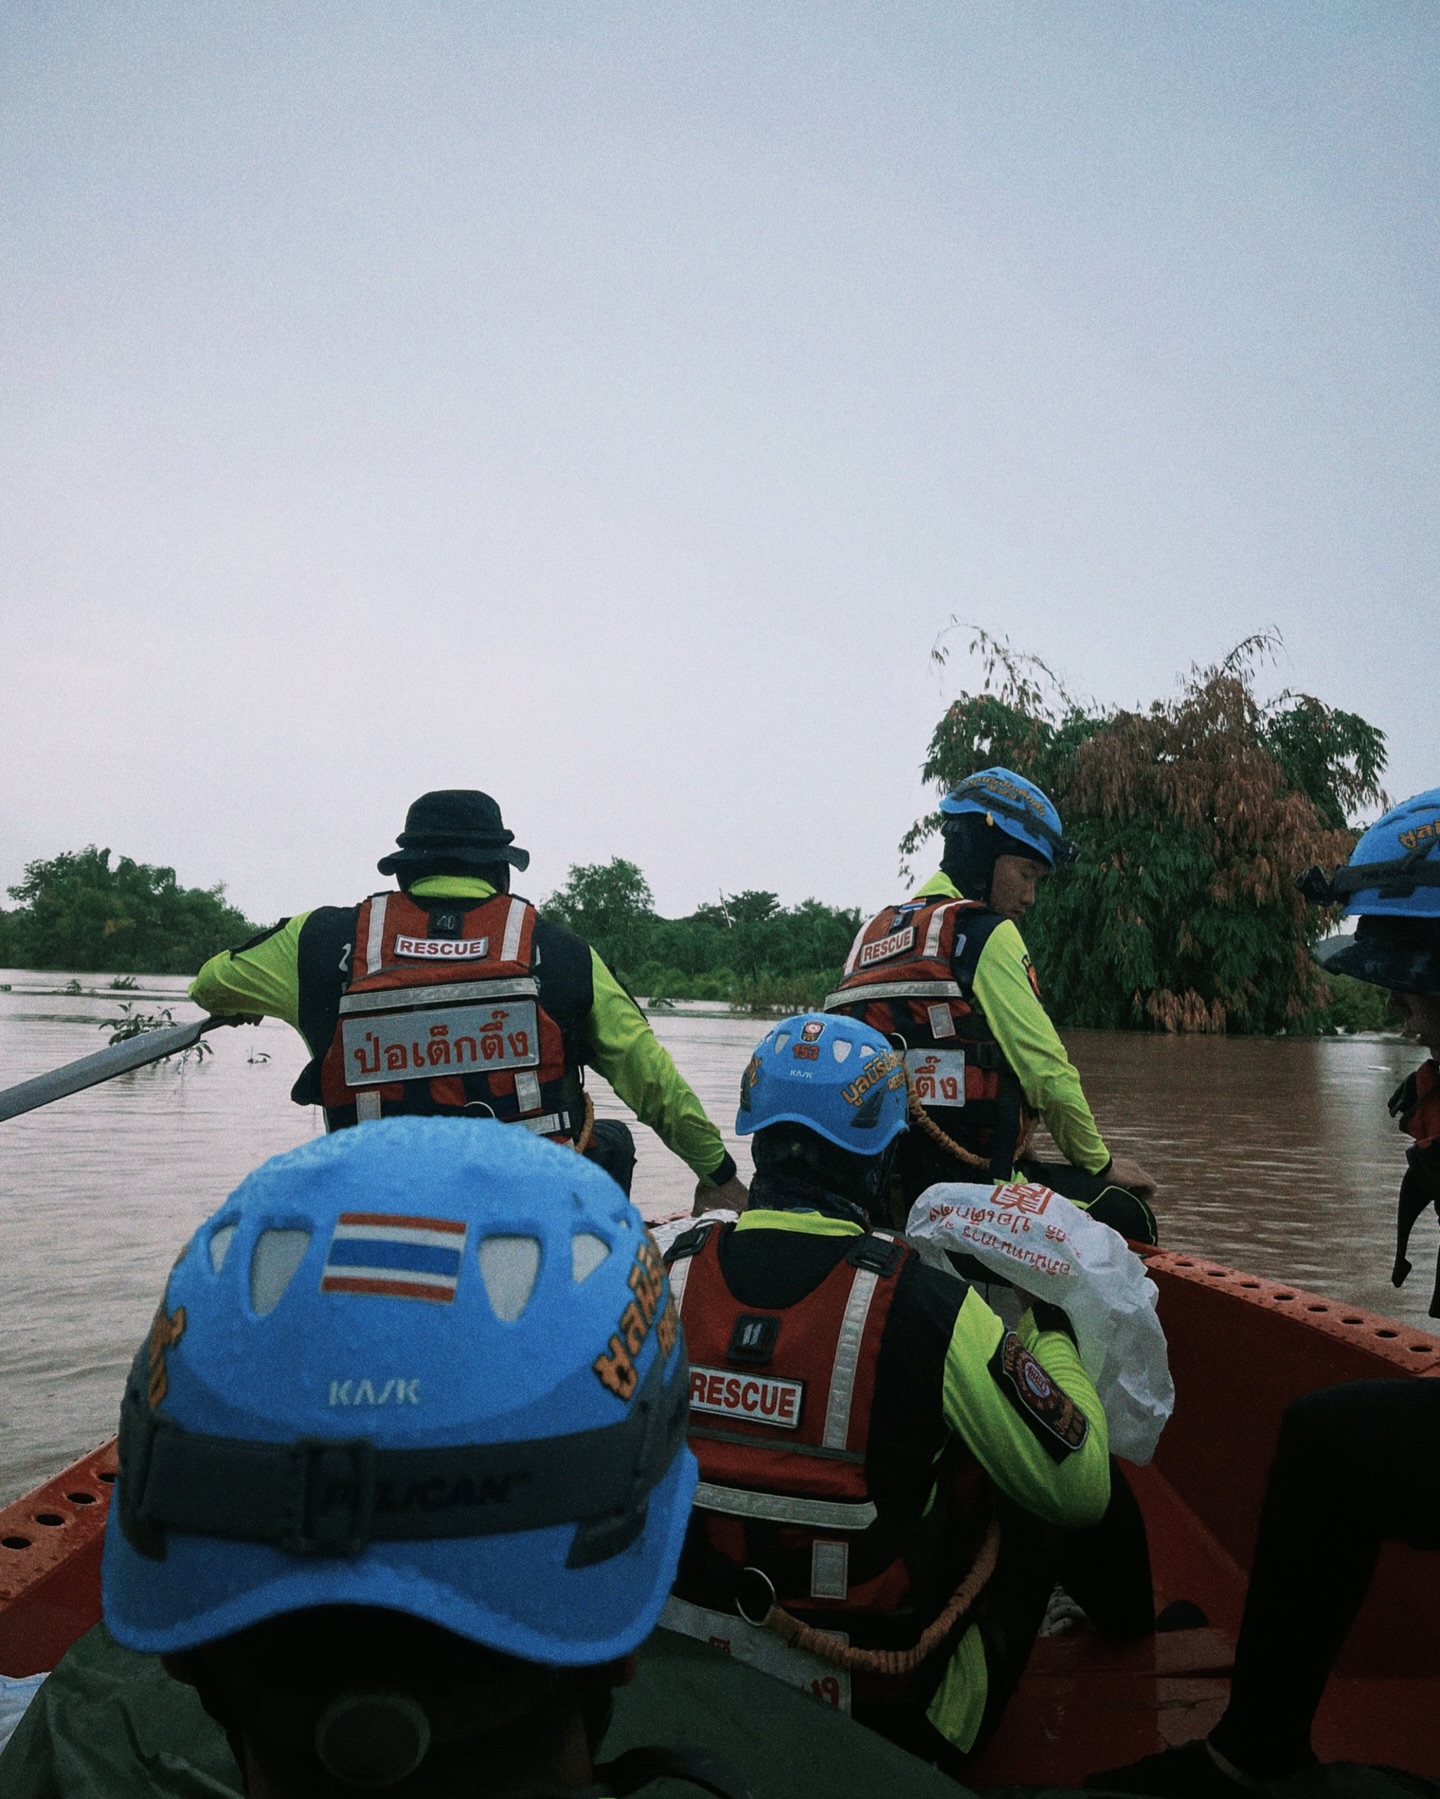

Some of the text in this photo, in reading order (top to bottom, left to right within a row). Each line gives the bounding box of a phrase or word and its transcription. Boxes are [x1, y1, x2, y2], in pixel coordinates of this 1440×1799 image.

[400, 940, 481, 955] RESCUE
[863, 930, 912, 961] RESCUE
[354, 1010, 529, 1073] ป่อเต็กตึ๊ง
[329, 1378, 420, 1406] KASK
[690, 1372, 797, 1418] RESCUE
